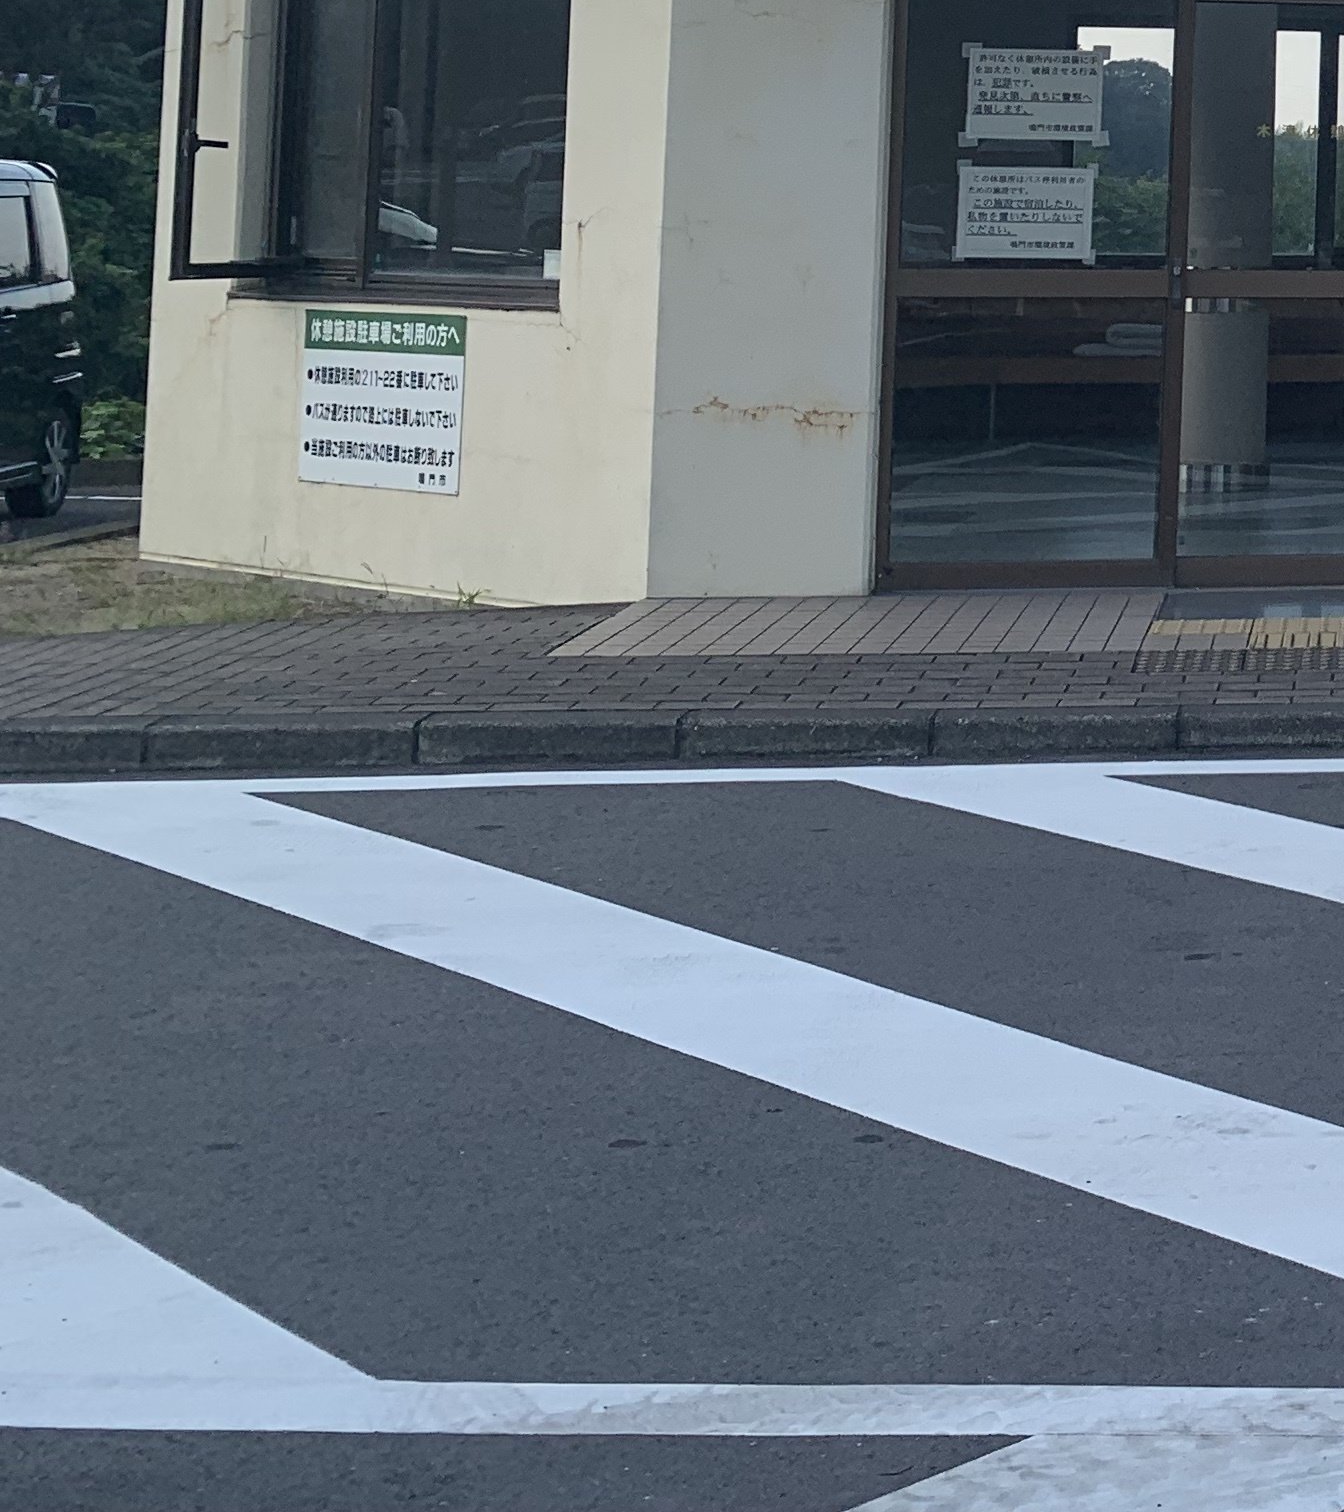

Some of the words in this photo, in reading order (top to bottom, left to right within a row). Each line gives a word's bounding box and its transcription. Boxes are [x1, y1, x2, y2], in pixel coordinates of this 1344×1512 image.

[310, 317, 460, 347] 休憩施設駐車場ご利用の方へ
